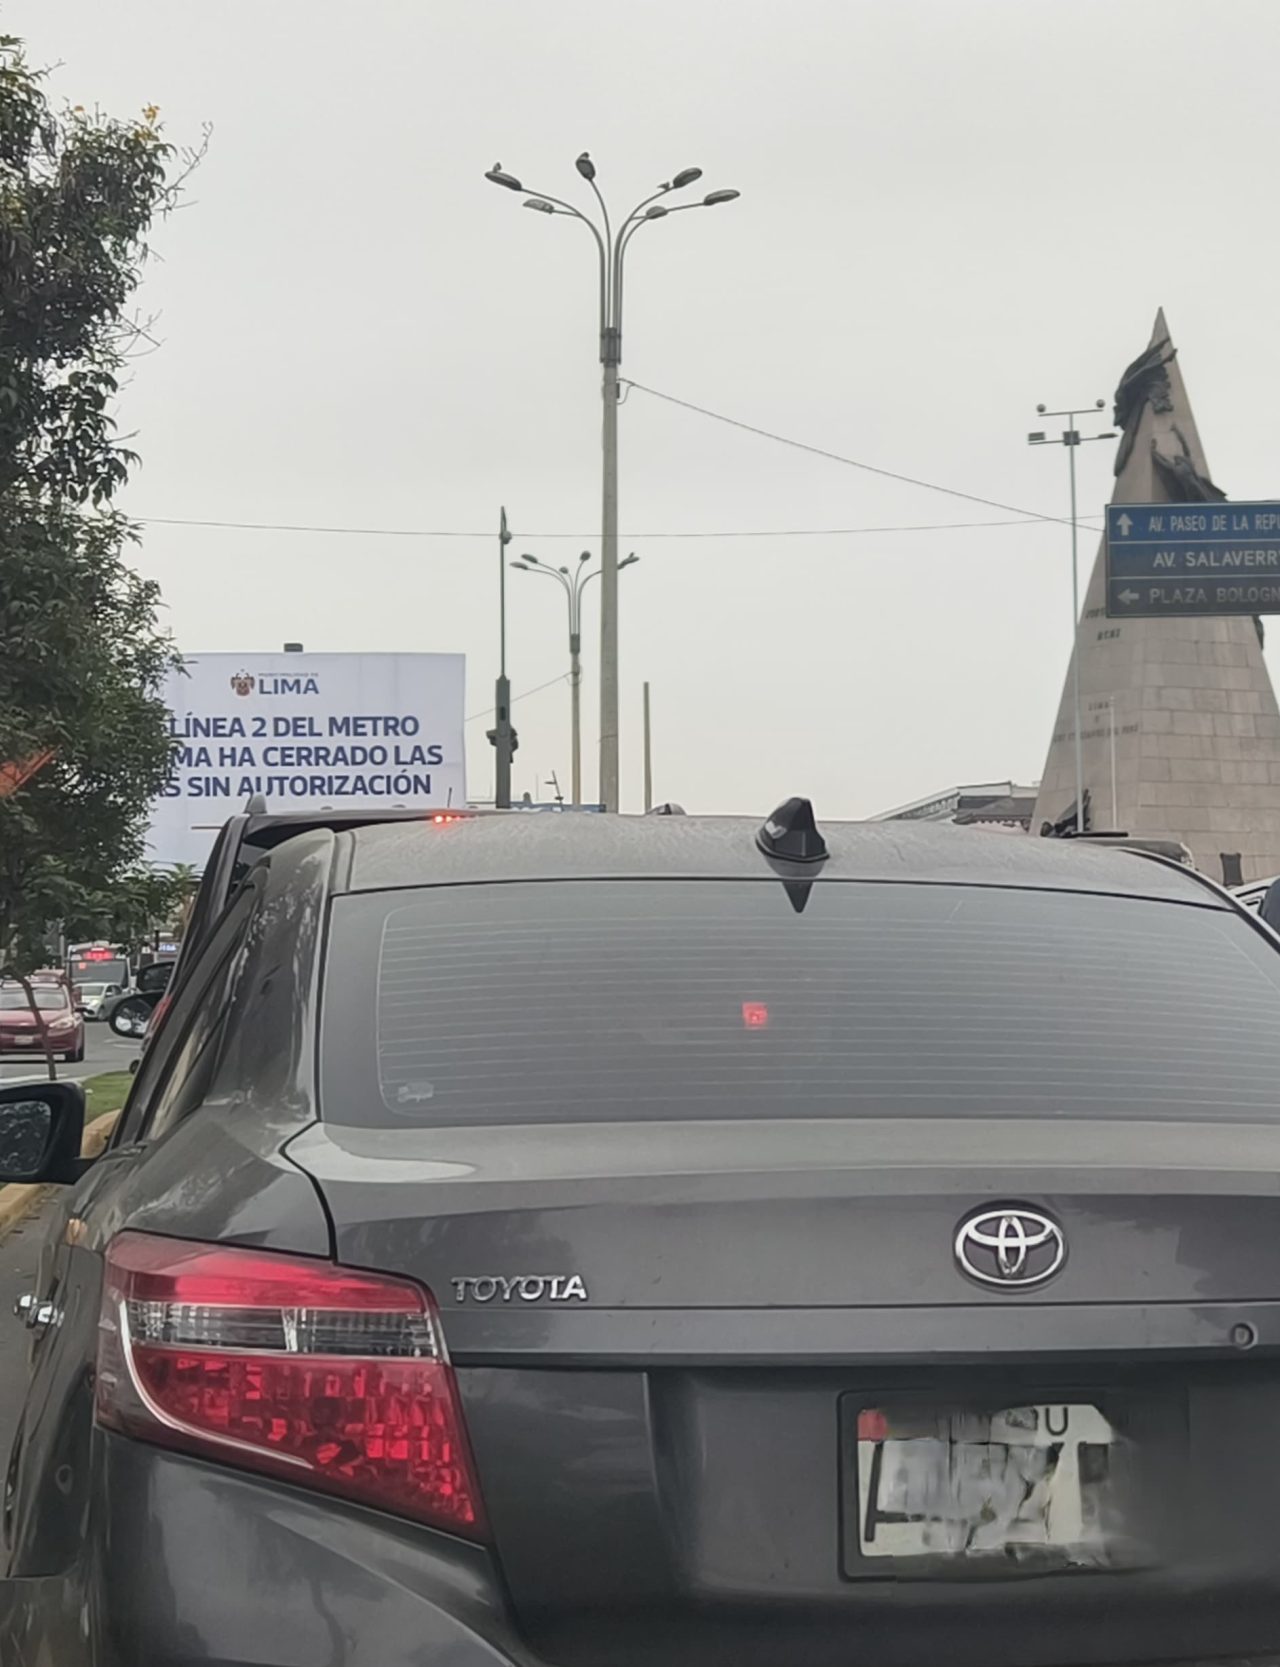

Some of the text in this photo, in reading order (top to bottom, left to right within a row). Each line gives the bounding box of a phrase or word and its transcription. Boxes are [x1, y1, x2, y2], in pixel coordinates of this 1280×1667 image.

[1171, 515, 1207, 532] PASEO
[1212, 514, 1228, 531] DE
[1233, 514, 1249, 530] LA
[1150, 588, 1207, 605] PLAZA
[259, 678, 320, 695] LIMA
[170, 711, 420, 738] LÍNEA 2 DEL METRO
[171, 745, 443, 768] MA HA CERRADO LAS
[187, 776, 231, 797] SIN
[237, 769, 432, 798] AUTORIZACIÓN
[452, 1275, 587, 1302] TOYOTA
